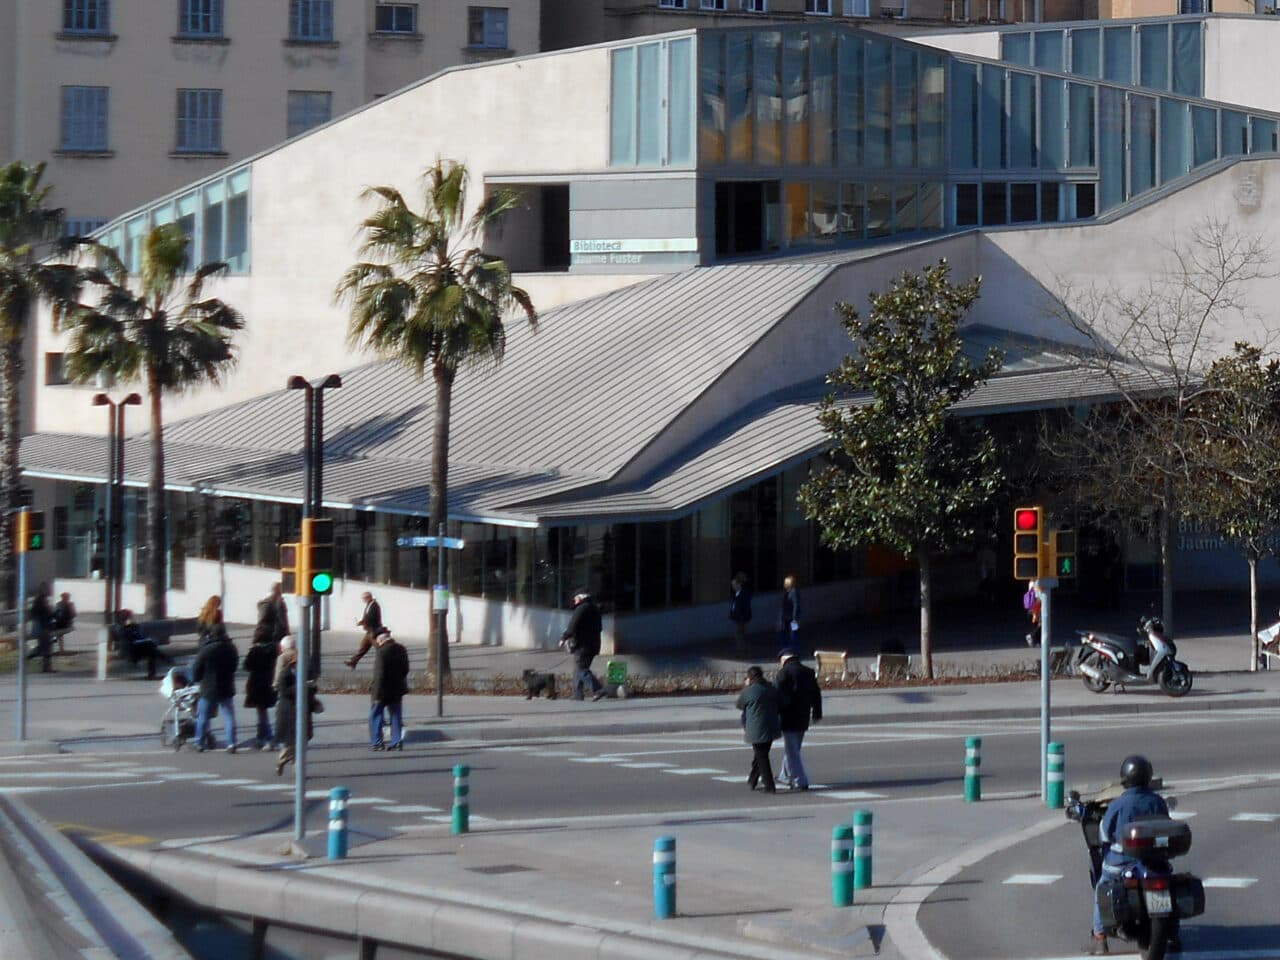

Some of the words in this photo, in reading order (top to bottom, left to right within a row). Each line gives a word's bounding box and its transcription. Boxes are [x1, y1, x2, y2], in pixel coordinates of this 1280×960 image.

[574, 240, 623, 251] Biblioteca
[574, 253, 607, 264] Jaume
[609, 253, 643, 264] Fuster
